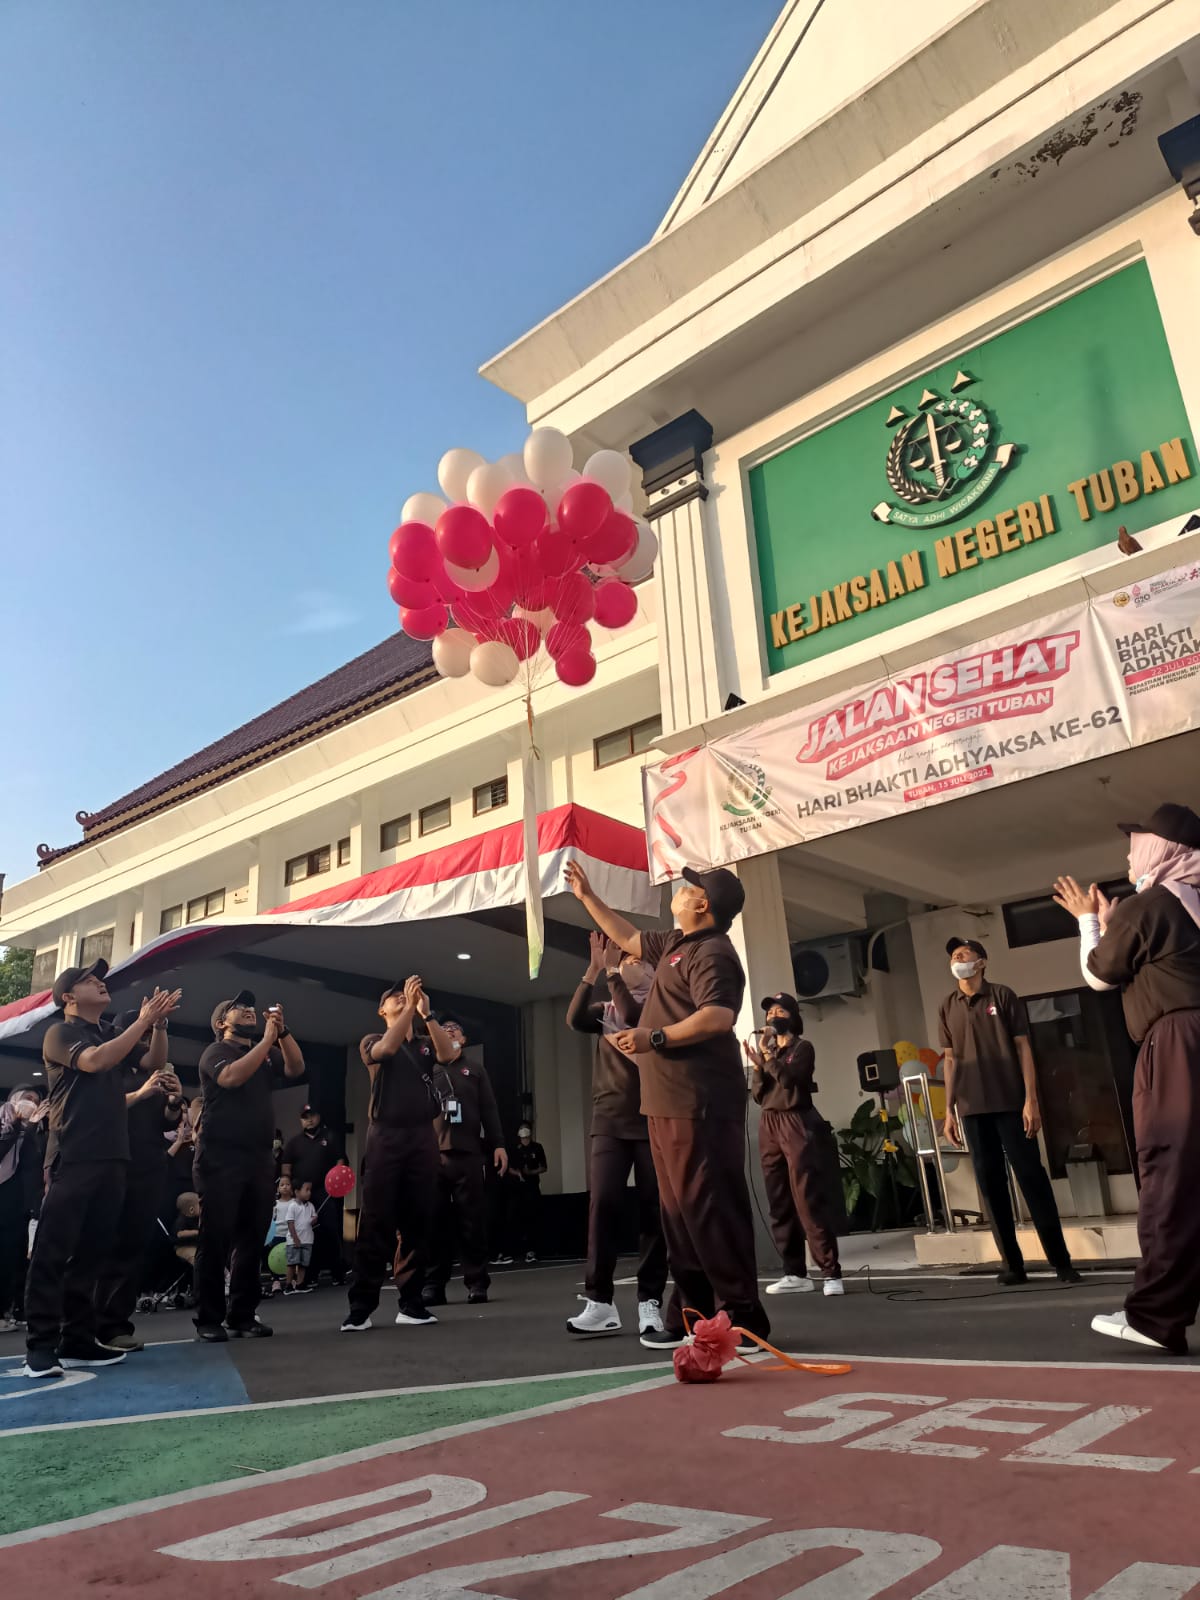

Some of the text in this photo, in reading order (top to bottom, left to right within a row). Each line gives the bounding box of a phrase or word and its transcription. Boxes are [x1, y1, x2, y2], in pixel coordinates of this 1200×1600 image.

[770, 437, 1192, 649] KEJAKSAAN NEGERI TUBAN
[893, 511, 919, 524] SATYA
[923, 511, 946, 523] ADHI
[1115, 622, 1164, 650] HARI
[1118, 626, 1193, 662] BHAKTI
[797, 632, 1079, 762] JALAN SEHAT
[828, 690, 1051, 777] KEJAKSAAN NEGERI TUBAN
[796, 706, 1122, 818] HARI BHAKTI ADHYAKSA KE-62
